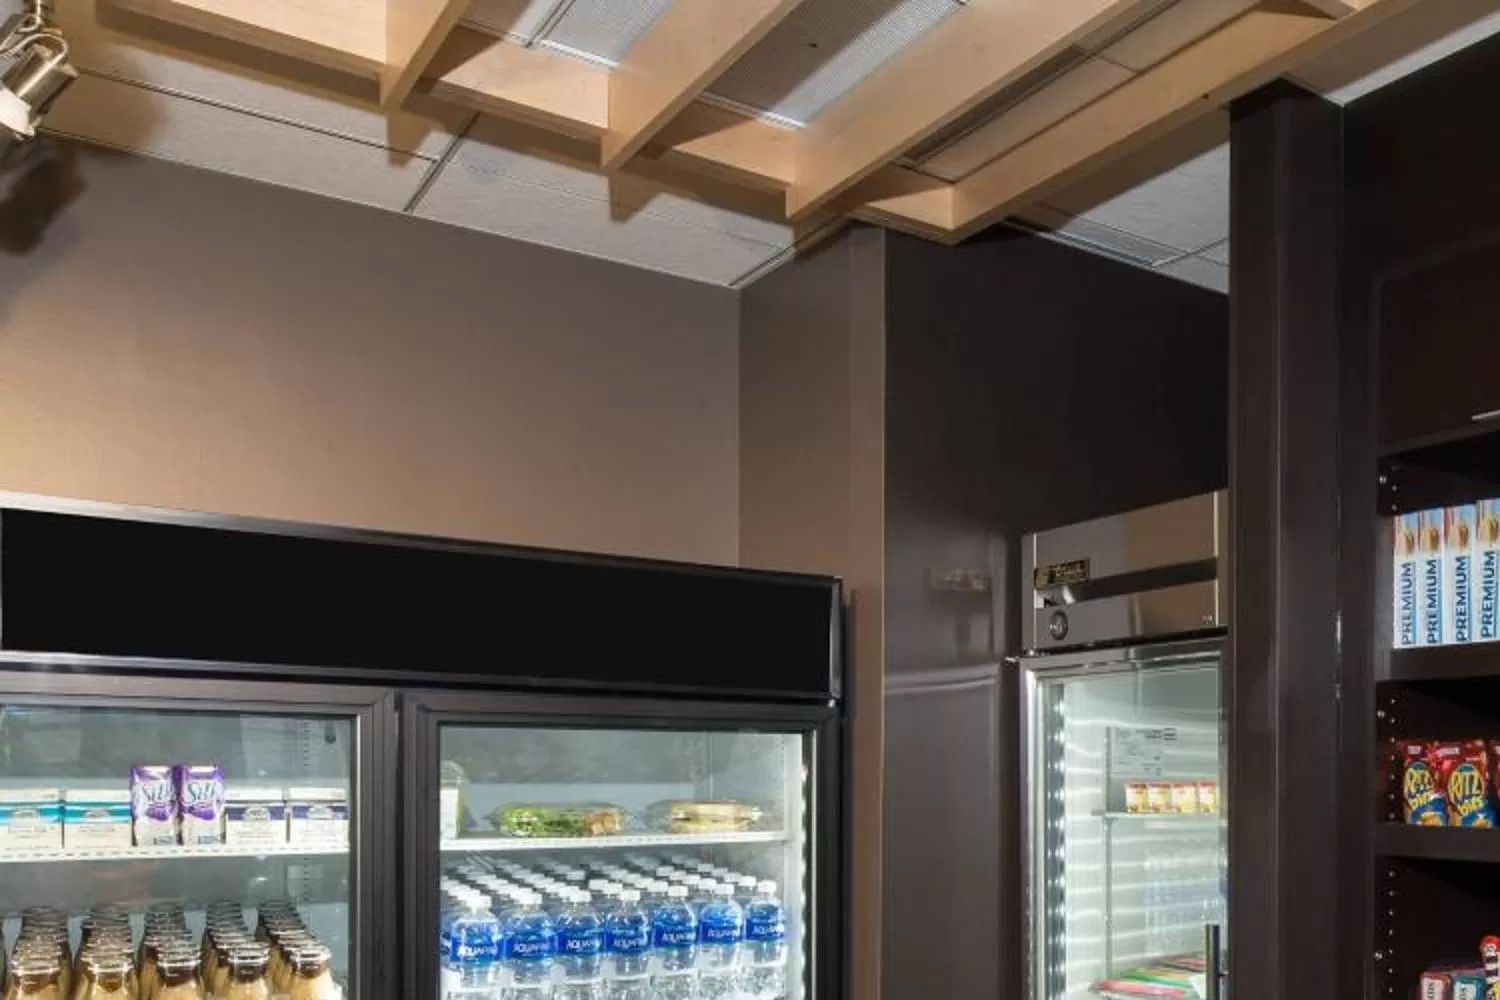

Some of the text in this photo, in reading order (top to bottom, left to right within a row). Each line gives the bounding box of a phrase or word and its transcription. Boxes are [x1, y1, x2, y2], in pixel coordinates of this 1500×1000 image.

[1401, 561, 1413, 644] PREMIUM
[1427, 559, 1438, 644] PREMIUM
[1455, 554, 1469, 642] PREMIUM
[1481, 550, 1497, 638] PREMIUM
